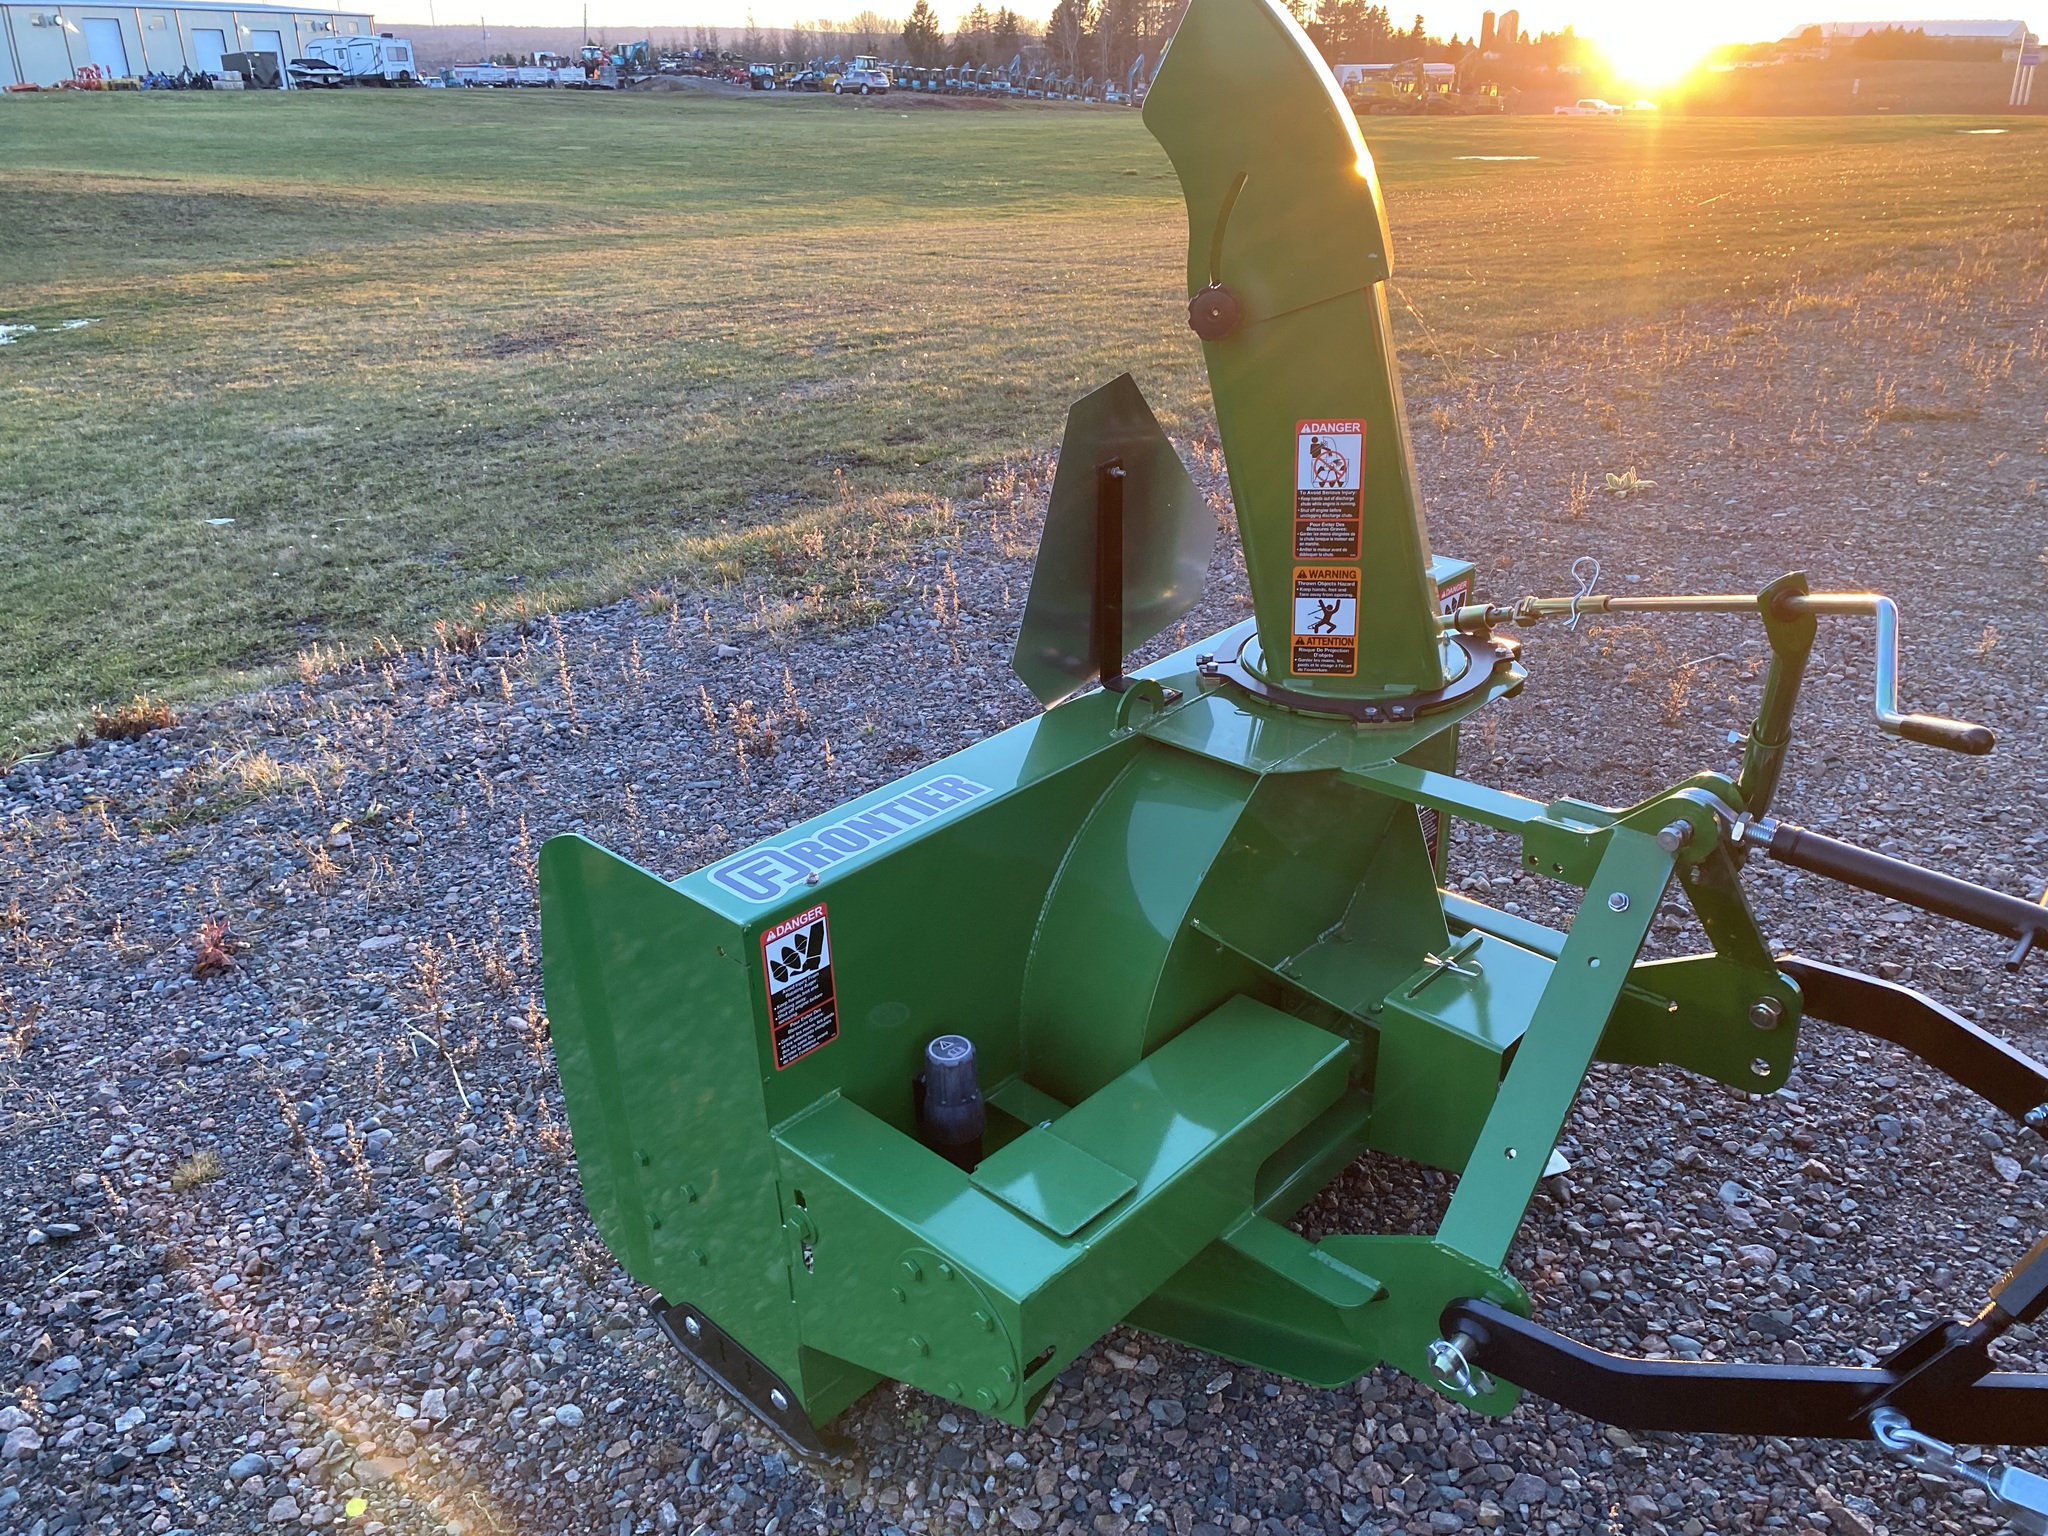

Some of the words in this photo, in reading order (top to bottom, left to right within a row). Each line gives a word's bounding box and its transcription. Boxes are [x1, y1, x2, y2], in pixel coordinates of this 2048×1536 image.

[1311, 423, 1360, 433] DANGER
[1309, 570, 1356, 579] WARNING
[1446, 581, 1467, 596] DANGER
[1306, 637, 1354, 646] ATTENTION
[714, 777, 986, 901] FRONTIER
[776, 906, 823, 937] DANGER
